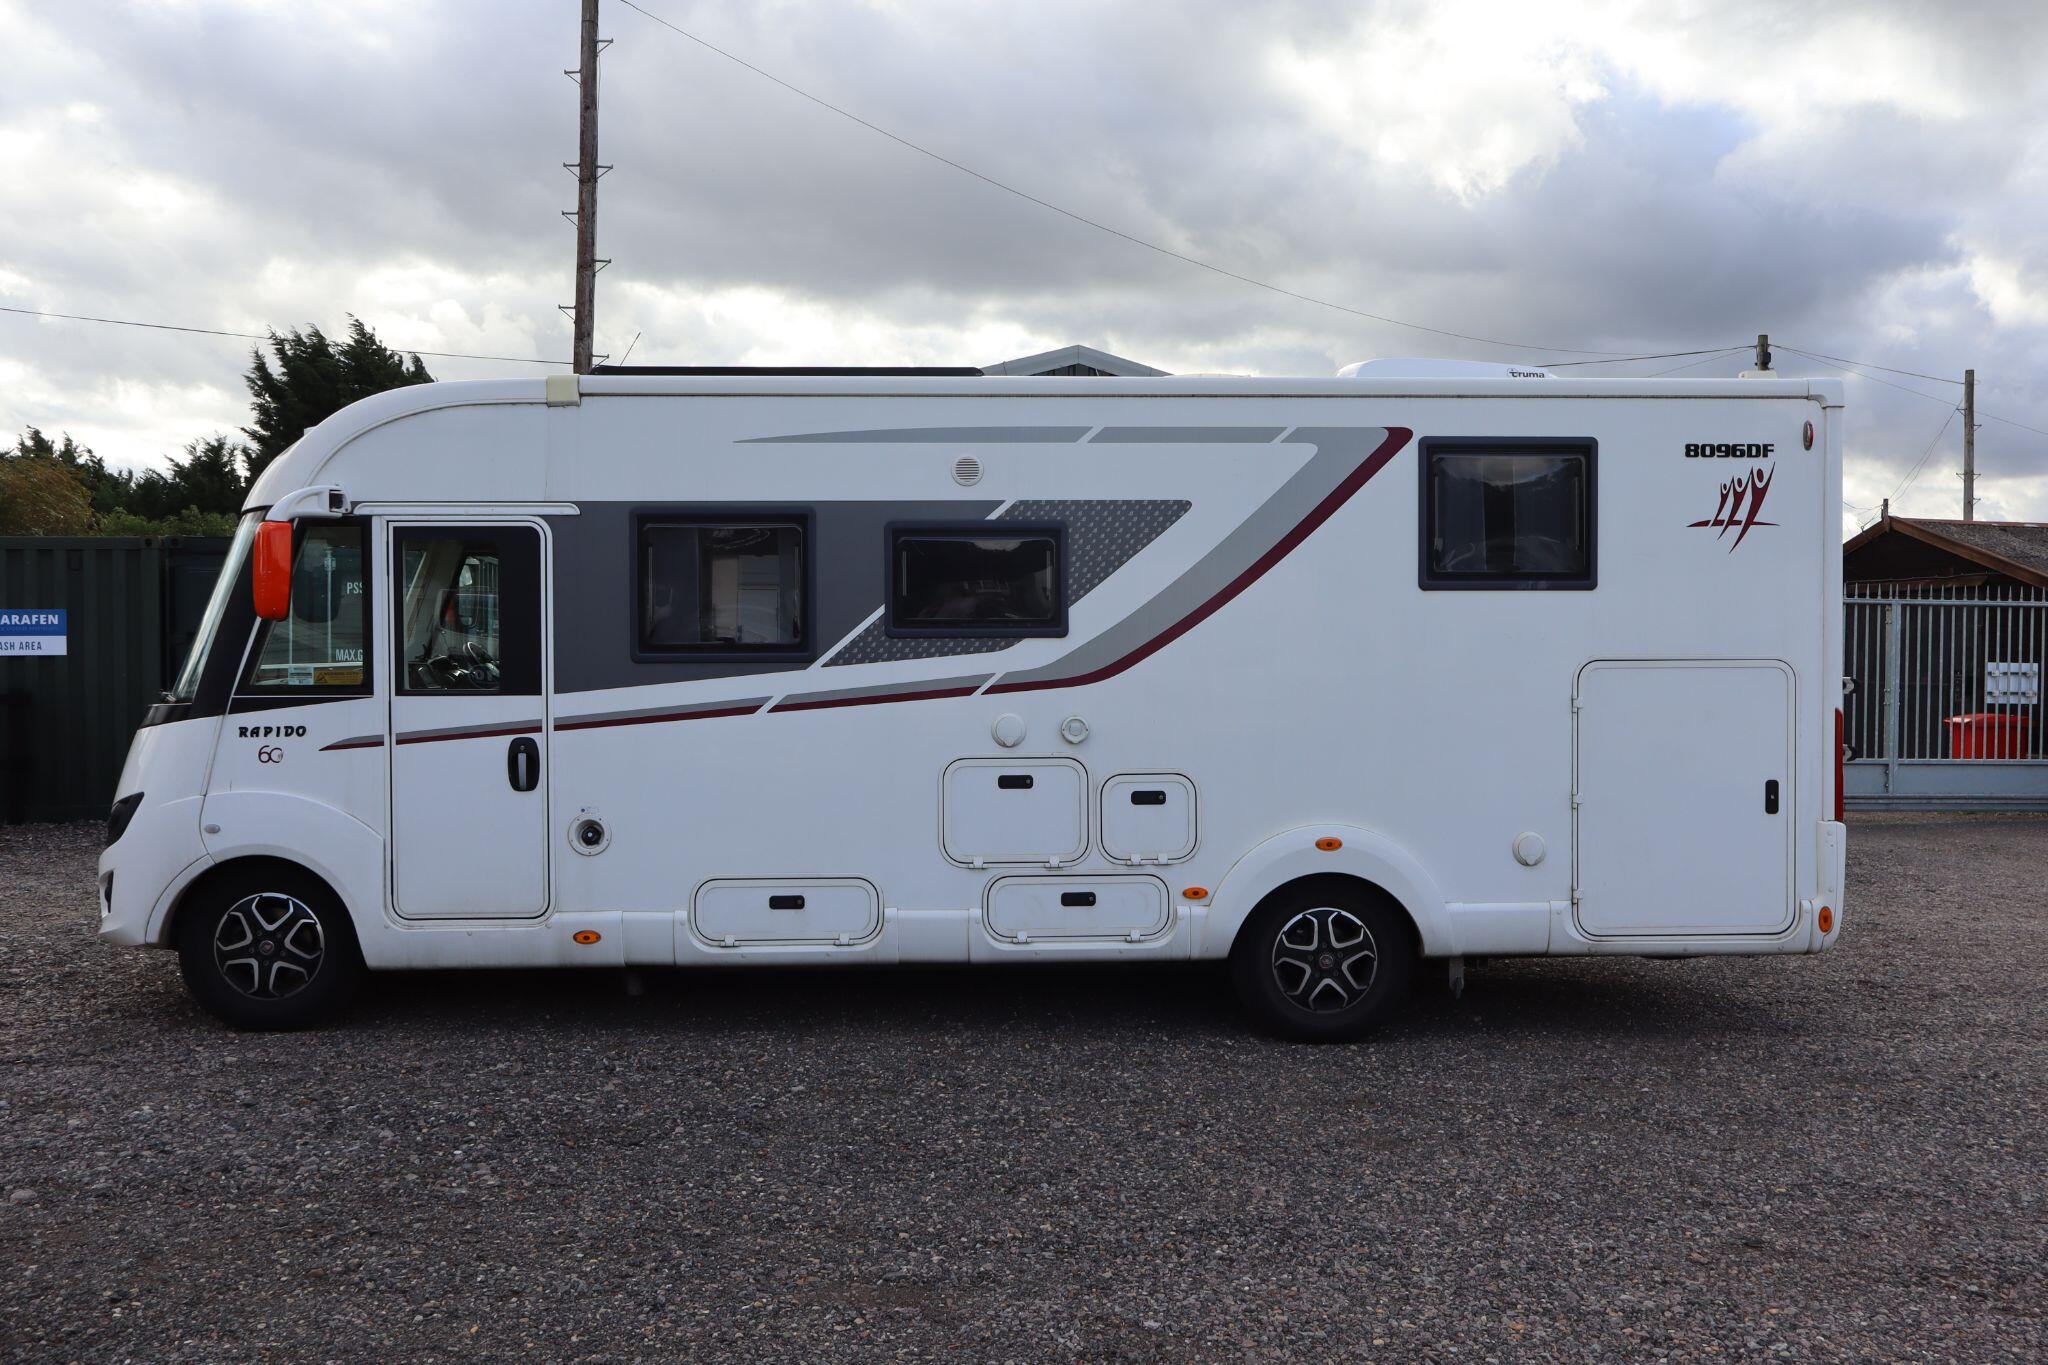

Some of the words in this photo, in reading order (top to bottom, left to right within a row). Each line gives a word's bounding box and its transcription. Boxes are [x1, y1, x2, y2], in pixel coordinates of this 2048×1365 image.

[1508, 369, 1545, 378] truma
[1684, 443, 1775, 458] 8096DF
[0, 614, 59, 625] ARAFEN
[19, 641, 42, 651] AREA
[238, 725, 307, 738] RAPIDO
